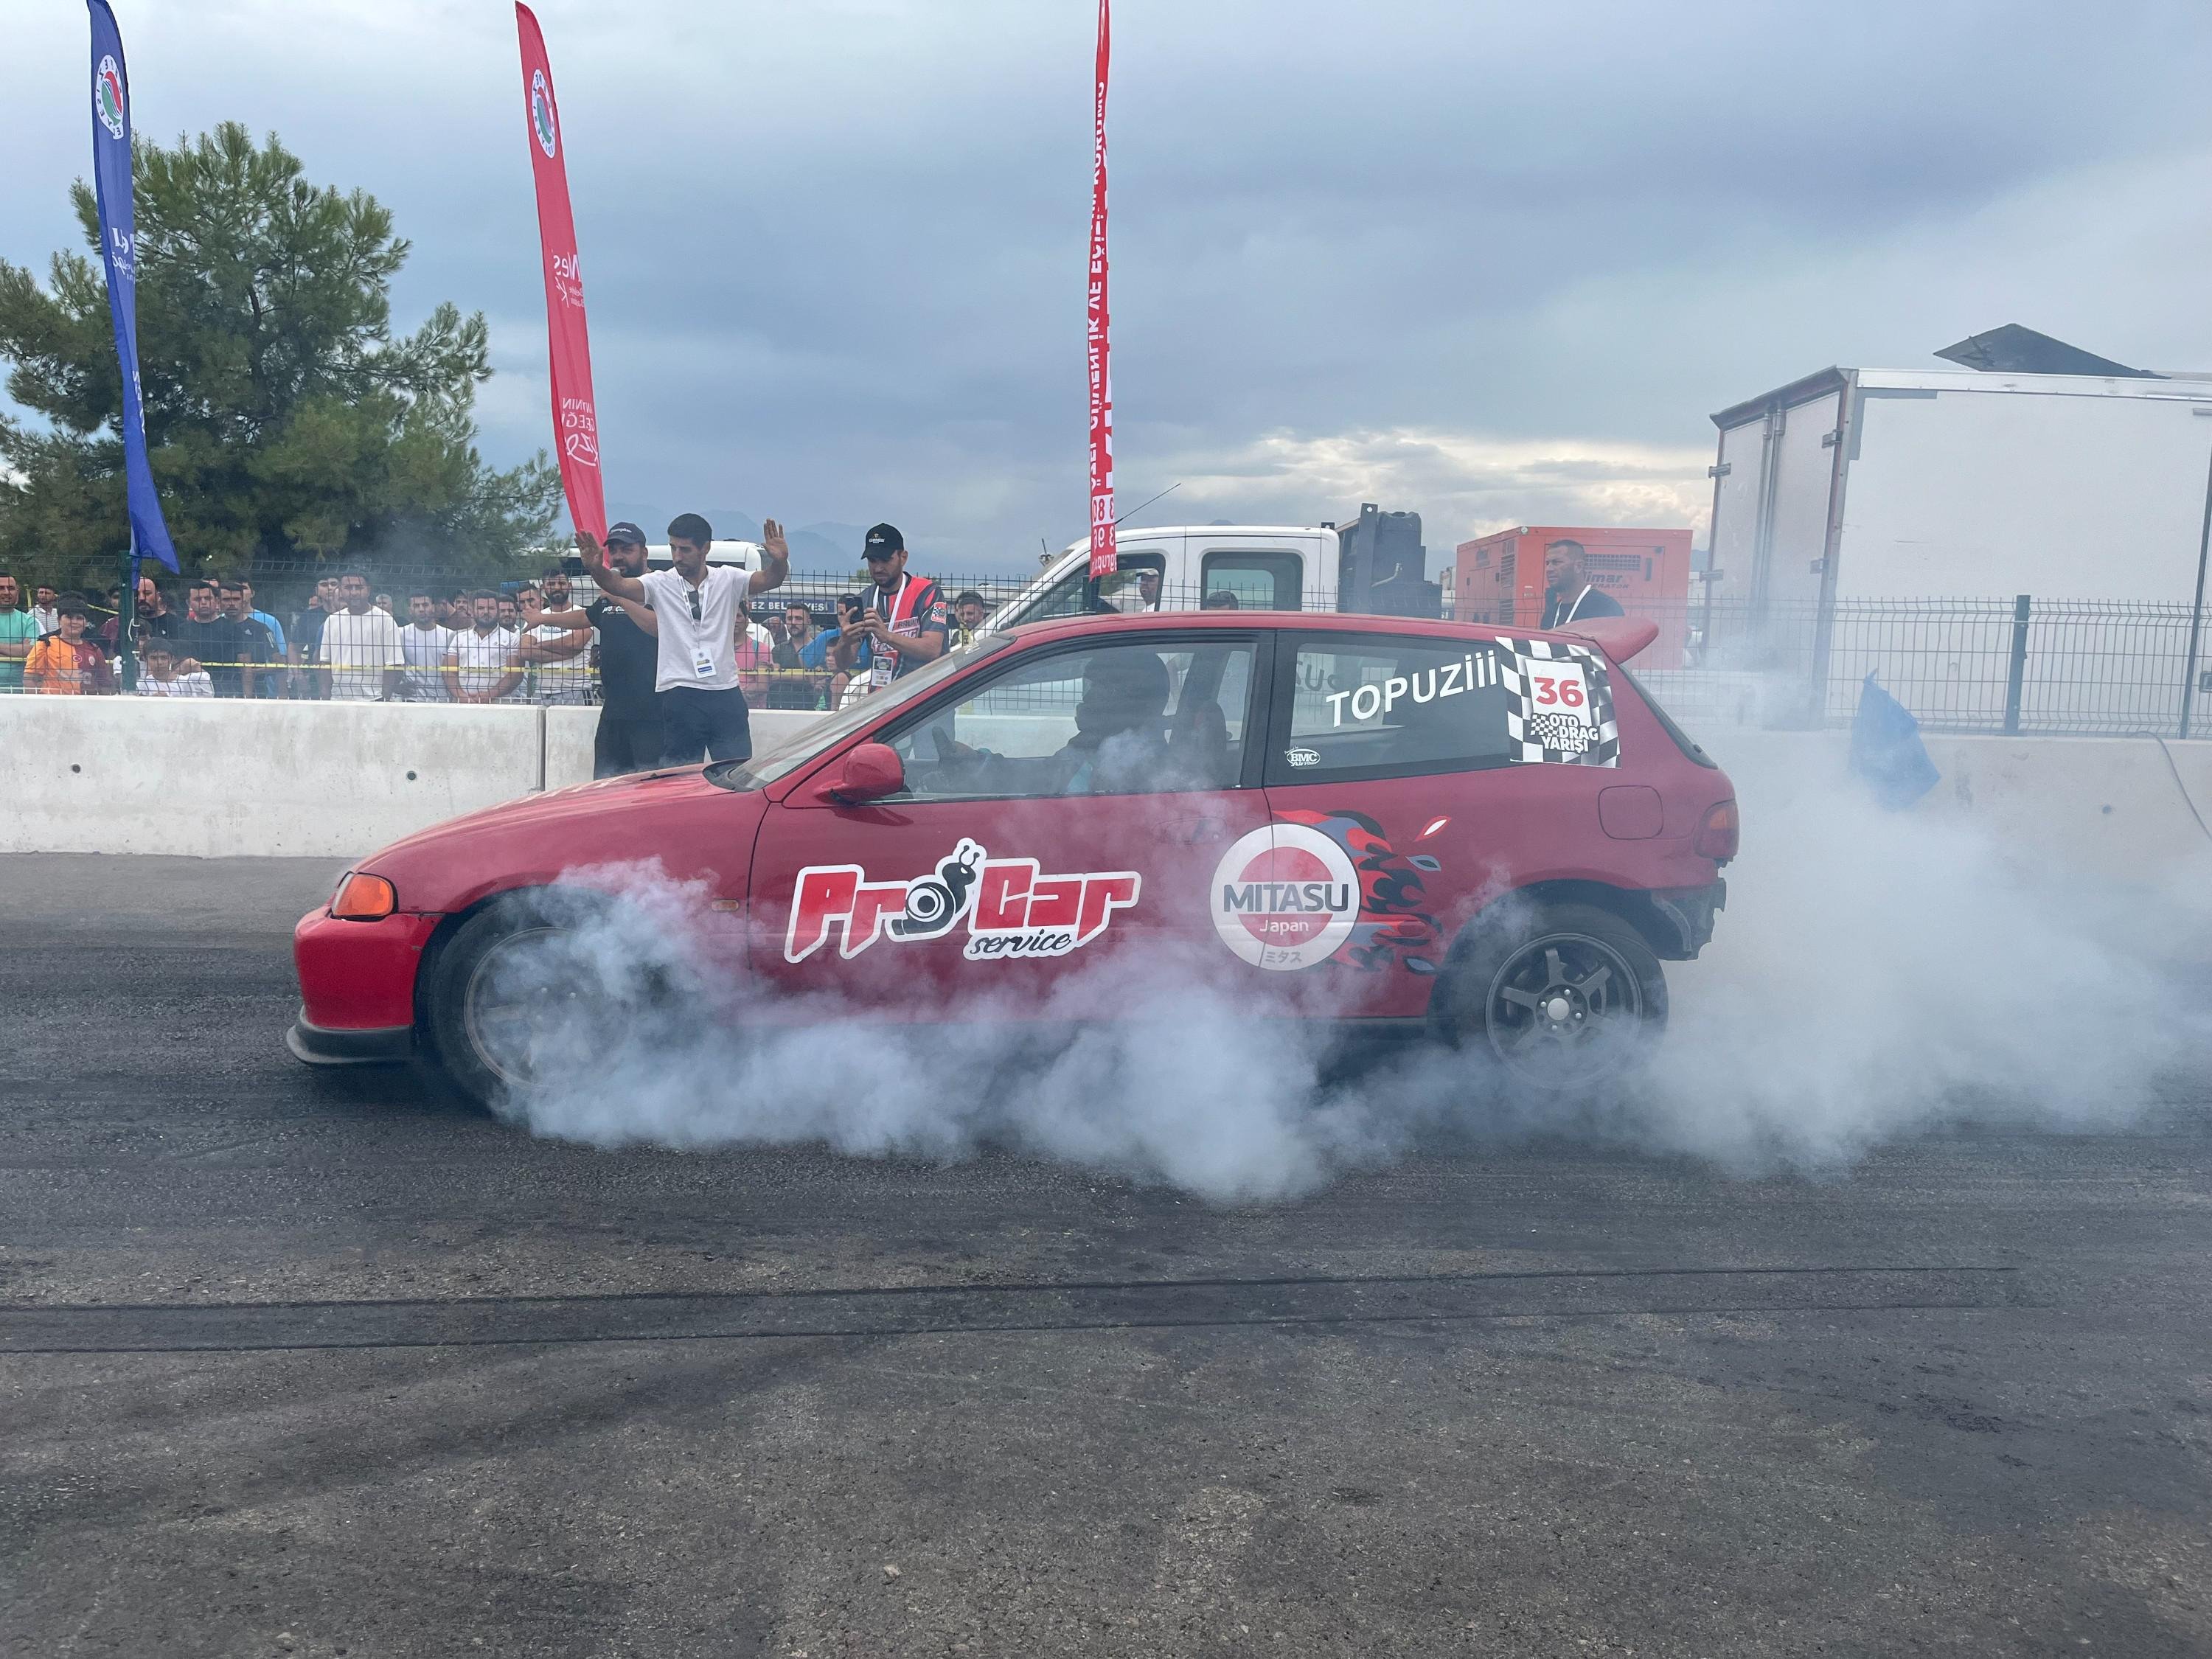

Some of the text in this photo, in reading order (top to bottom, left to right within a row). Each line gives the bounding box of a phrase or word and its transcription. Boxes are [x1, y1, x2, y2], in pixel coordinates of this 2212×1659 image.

[1326, 650, 1498, 728] TOPUZiii
[1534, 676, 1584, 706] 36
[1549, 714, 1579, 728] OTO
[1559, 726, 1599, 741] DRAG
[1542, 734, 1589, 754] YARIŞI
[1290, 754, 1318, 762] BMC
[974, 860, 1139, 945] Car
[1223, 883, 1349, 913] MITASU
[1259, 919, 1310, 935] Japan
[970, 928, 1071, 956] service
[1265, 949, 1303, 964] ミタス
